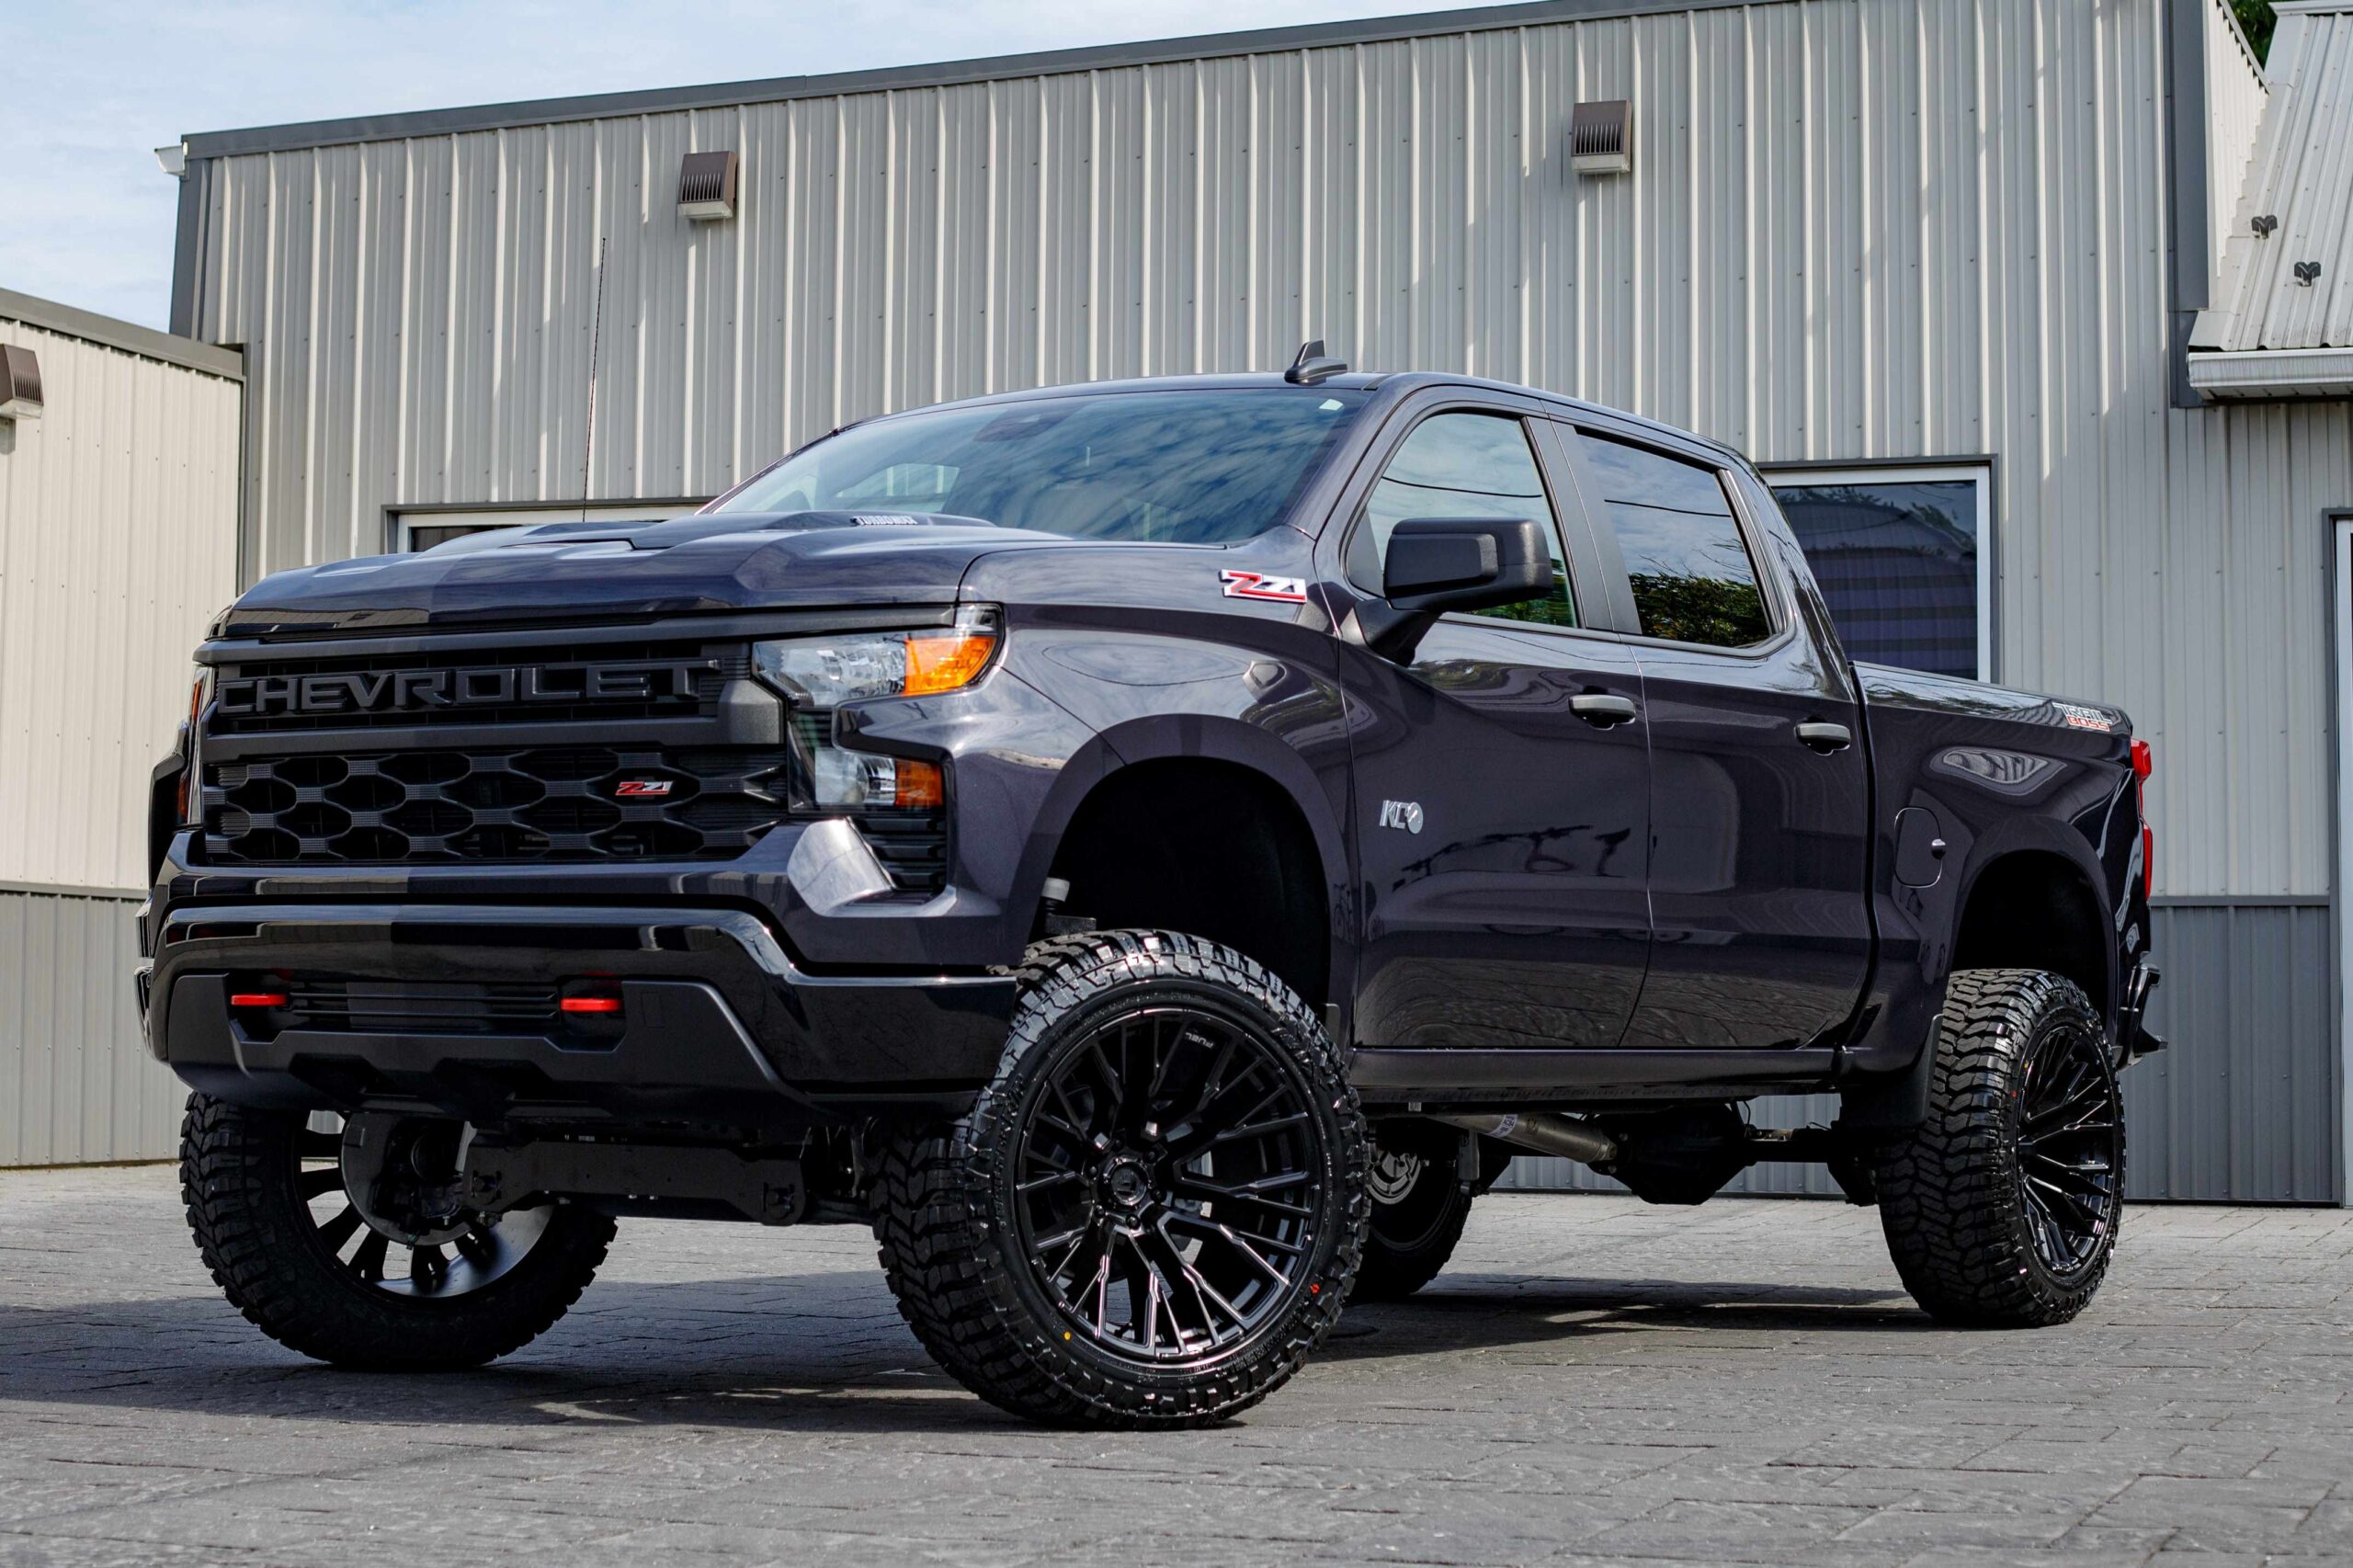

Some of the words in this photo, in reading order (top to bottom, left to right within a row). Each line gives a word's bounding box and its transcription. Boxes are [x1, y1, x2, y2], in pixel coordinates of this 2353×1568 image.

[1219, 569, 1307, 603] Z71
[217, 659, 720, 713] CHEVROLET
[2052, 702, 2112, 725] TRAIL
[2066, 715, 2109, 732] BOSS
[615, 780, 673, 796] Z71
[1186, 1032, 1214, 1048] FUEL
